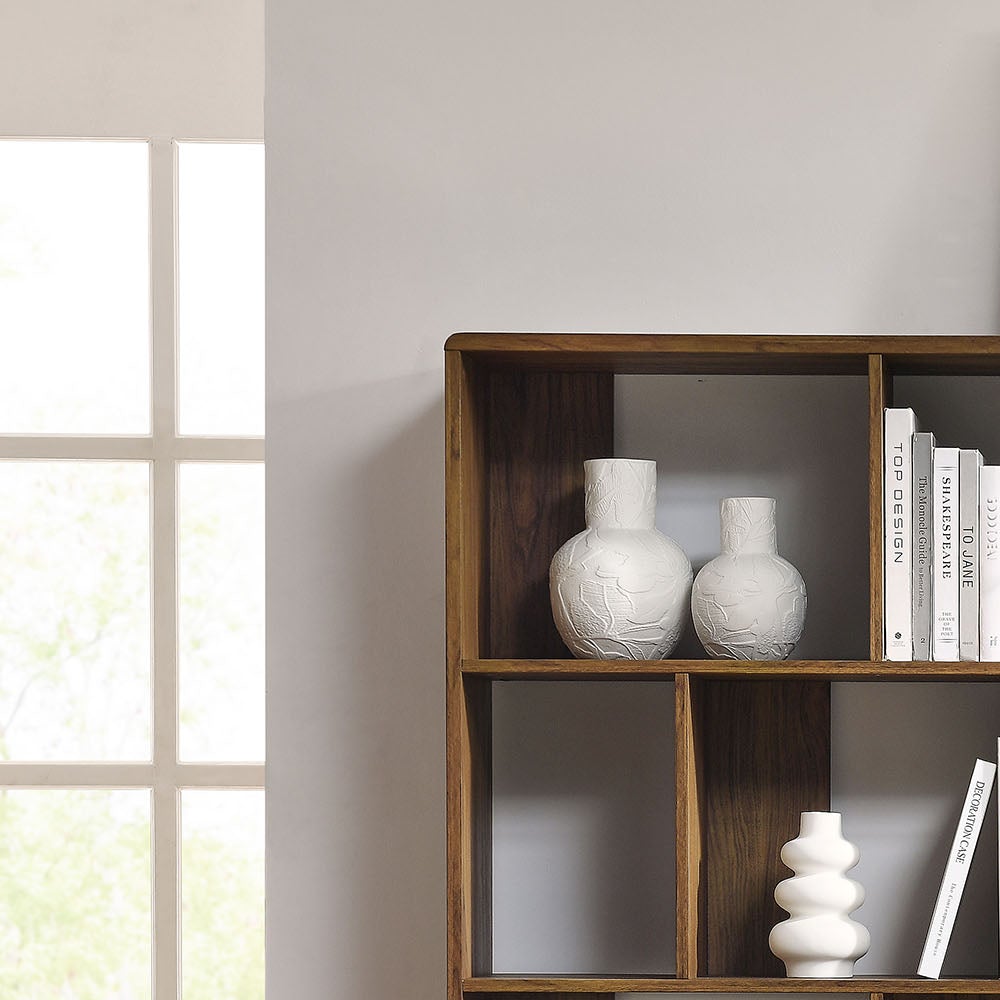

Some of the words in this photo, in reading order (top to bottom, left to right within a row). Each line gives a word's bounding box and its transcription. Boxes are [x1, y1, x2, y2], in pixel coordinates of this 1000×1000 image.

[894, 443, 903, 481] TOP
[919, 476, 928, 494] The
[894, 490, 903, 563] DESIGN
[919, 496, 928, 535] Monocle
[942, 477, 952, 579] SHAKESPEARE
[919, 537, 928, 564] Guide
[962, 527, 974, 543] TO
[962, 550, 973, 588] JANE
[963, 781, 985, 840] DECORATION
[955, 840, 969, 864] CASE
[937, 895, 953, 937] Contemporary
